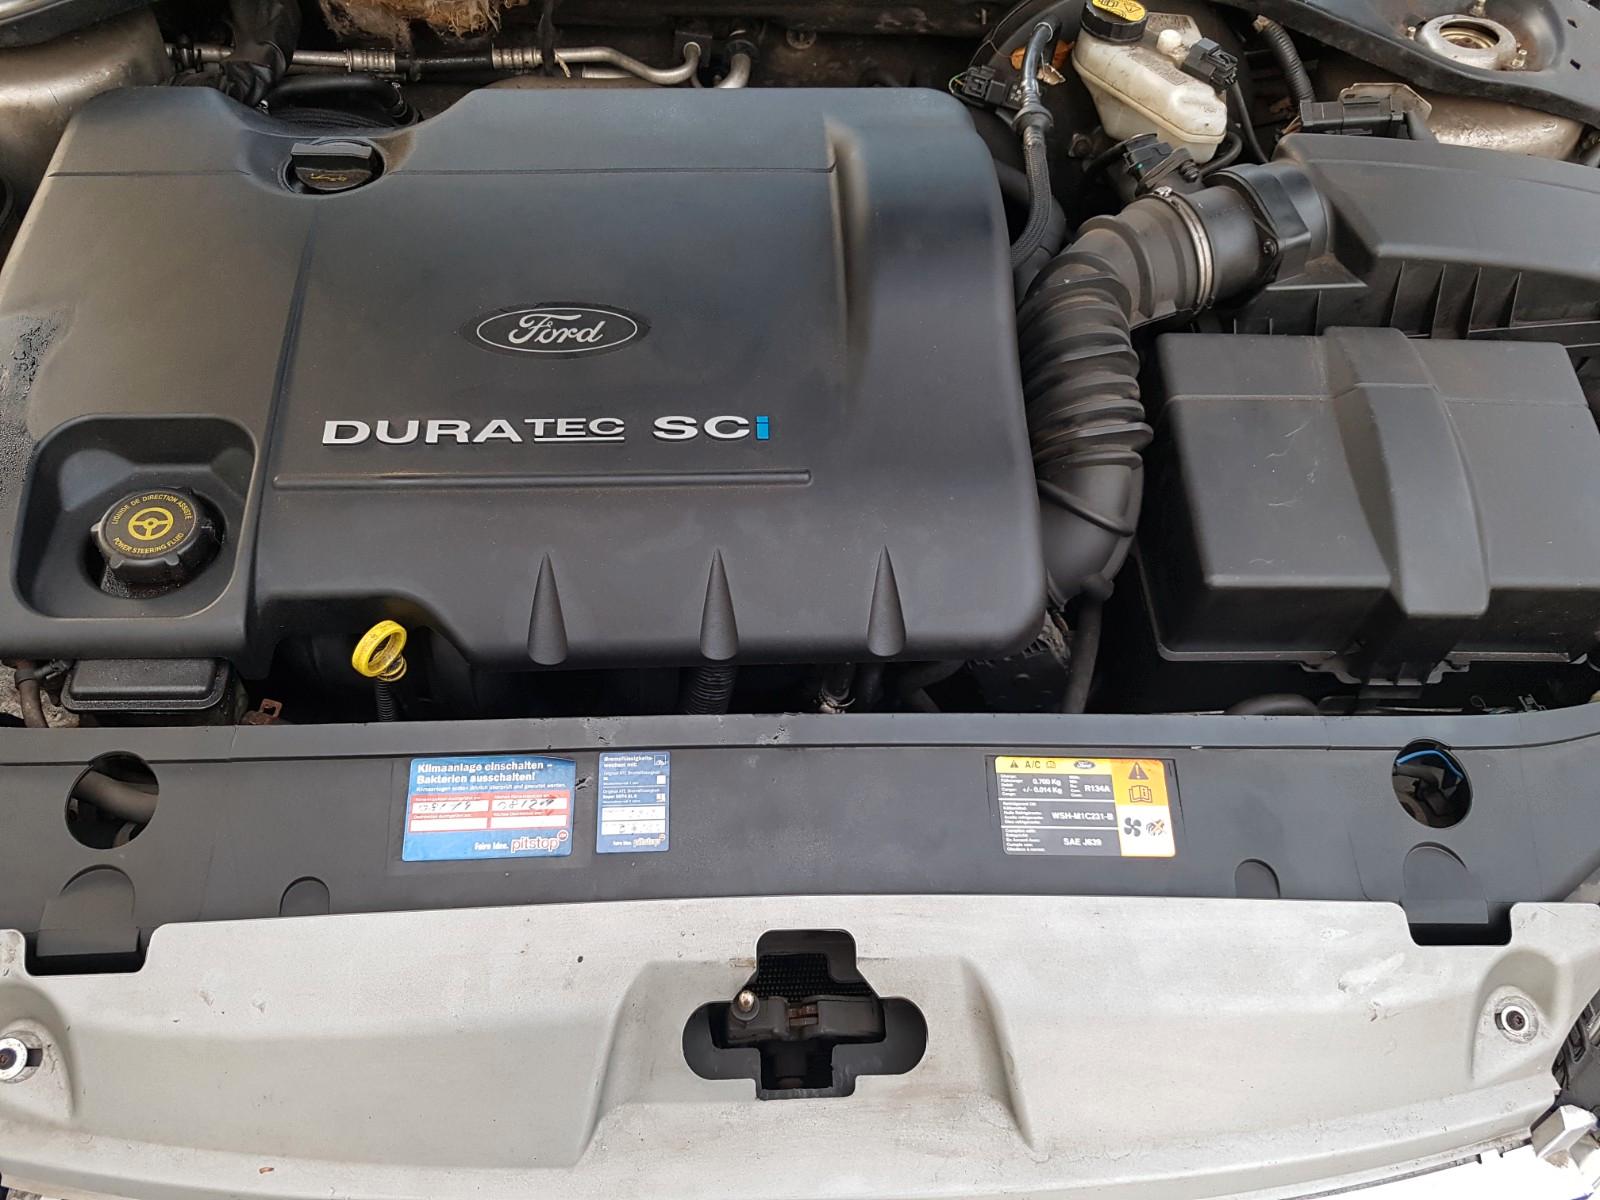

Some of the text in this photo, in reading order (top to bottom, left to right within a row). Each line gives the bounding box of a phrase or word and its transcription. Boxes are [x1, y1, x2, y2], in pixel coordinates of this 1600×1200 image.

[508, 313, 604, 344] Ford
[321, 415, 769, 445] DURATEC SCi
[112, 504, 129, 525] LIQUIDE
[143, 494, 178, 503] DIRECTION
[114, 532, 185, 554] POWER STEERING FLUID
[418, 762, 482, 773] Klimaanlage
[485, 761, 543, 771] einschalten
[1025, 761, 1041, 769] A/C
[416, 772, 536, 785] Bakterien ausschalten!
[1051, 778, 1062, 787] Kg
[1052, 787, 1063, 795] Kg
[1084, 784, 1111, 793] R134A
[511, 836, 560, 853] pitstop
[1063, 837, 1081, 846] SAE
